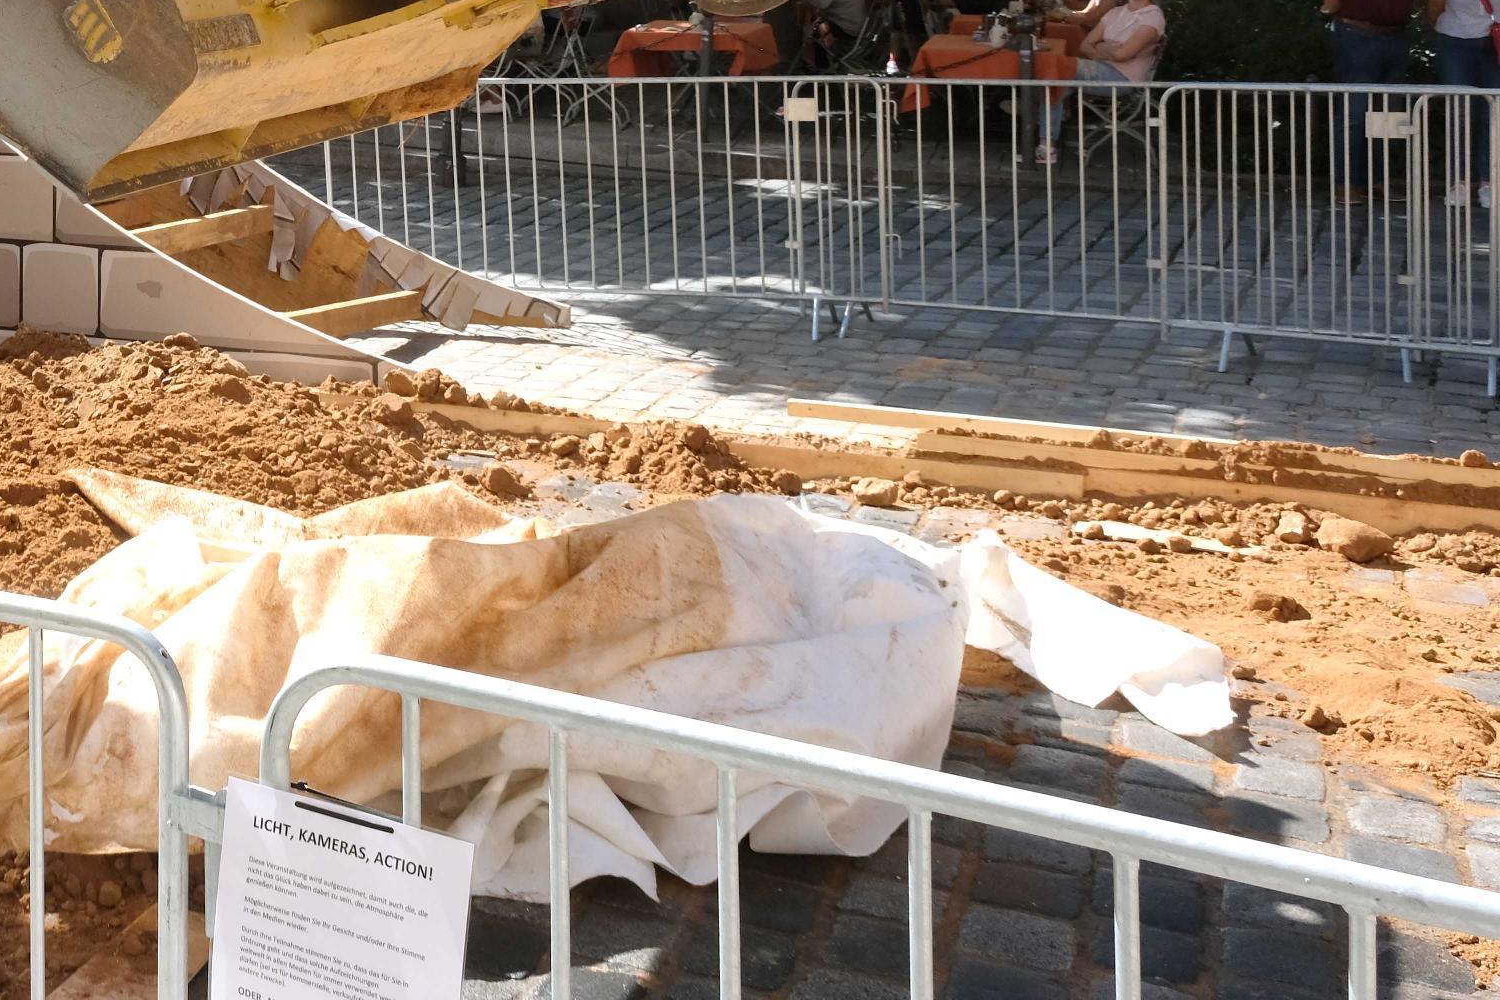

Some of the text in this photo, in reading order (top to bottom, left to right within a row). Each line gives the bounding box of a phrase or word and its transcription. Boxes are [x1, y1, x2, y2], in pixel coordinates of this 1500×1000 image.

[253, 815, 433, 881] LICHT, KAMERAS, ACTION!
[368, 893, 387, 905] damit
